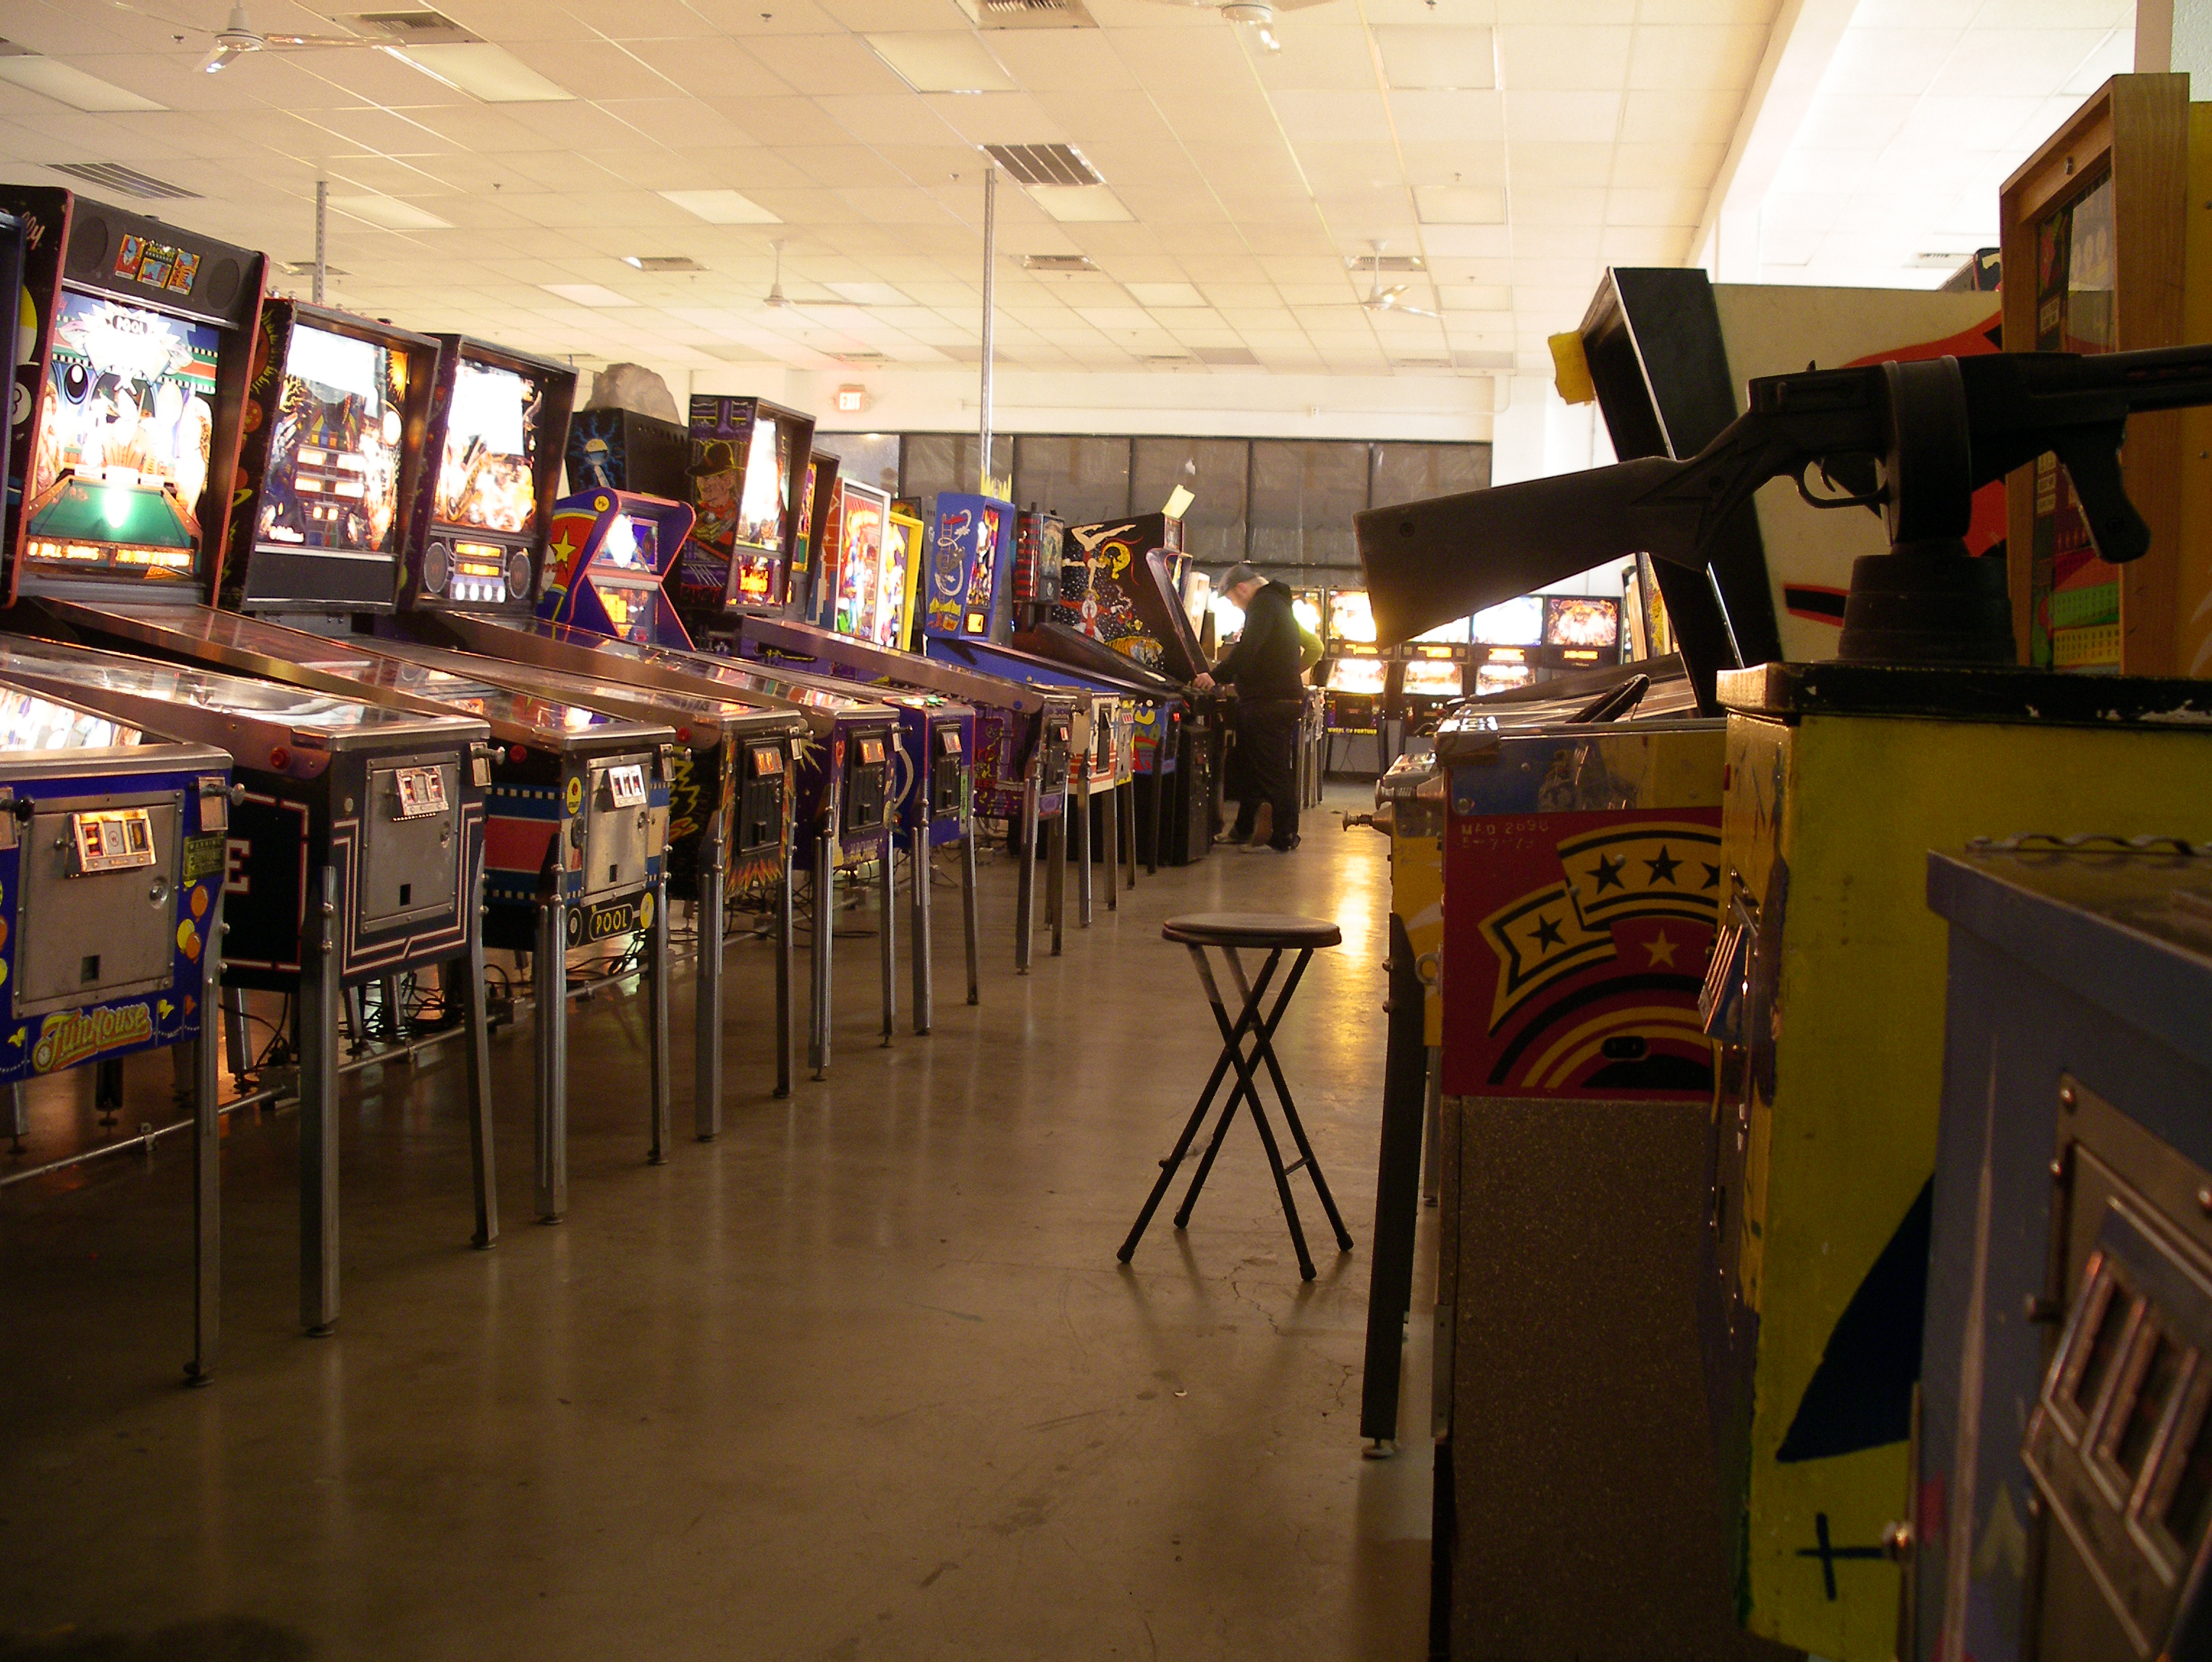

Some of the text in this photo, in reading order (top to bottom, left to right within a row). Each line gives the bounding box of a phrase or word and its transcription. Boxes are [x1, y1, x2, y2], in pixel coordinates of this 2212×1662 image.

[115, 316, 147, 335] POOL
[839, 392, 860, 410] EXIT
[596, 908, 628, 935] POOL
